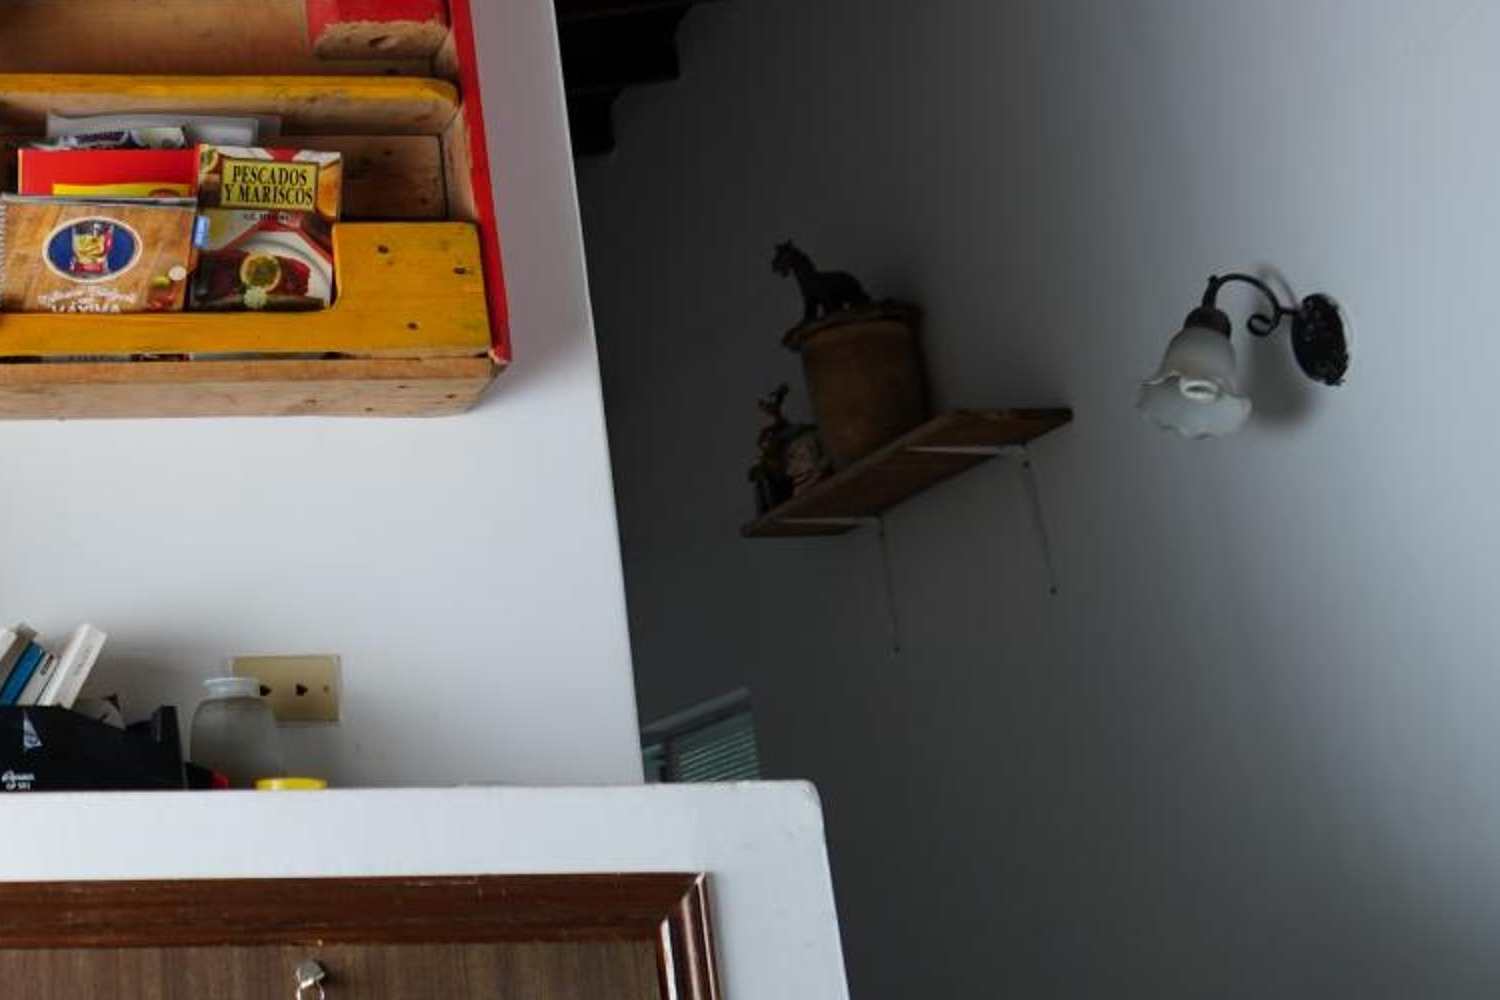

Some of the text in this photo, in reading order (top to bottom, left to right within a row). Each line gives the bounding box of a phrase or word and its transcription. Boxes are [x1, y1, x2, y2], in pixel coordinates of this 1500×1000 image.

[233, 165, 307, 186] PESCADOS
[225, 184, 313, 205] Y MARISCOS
